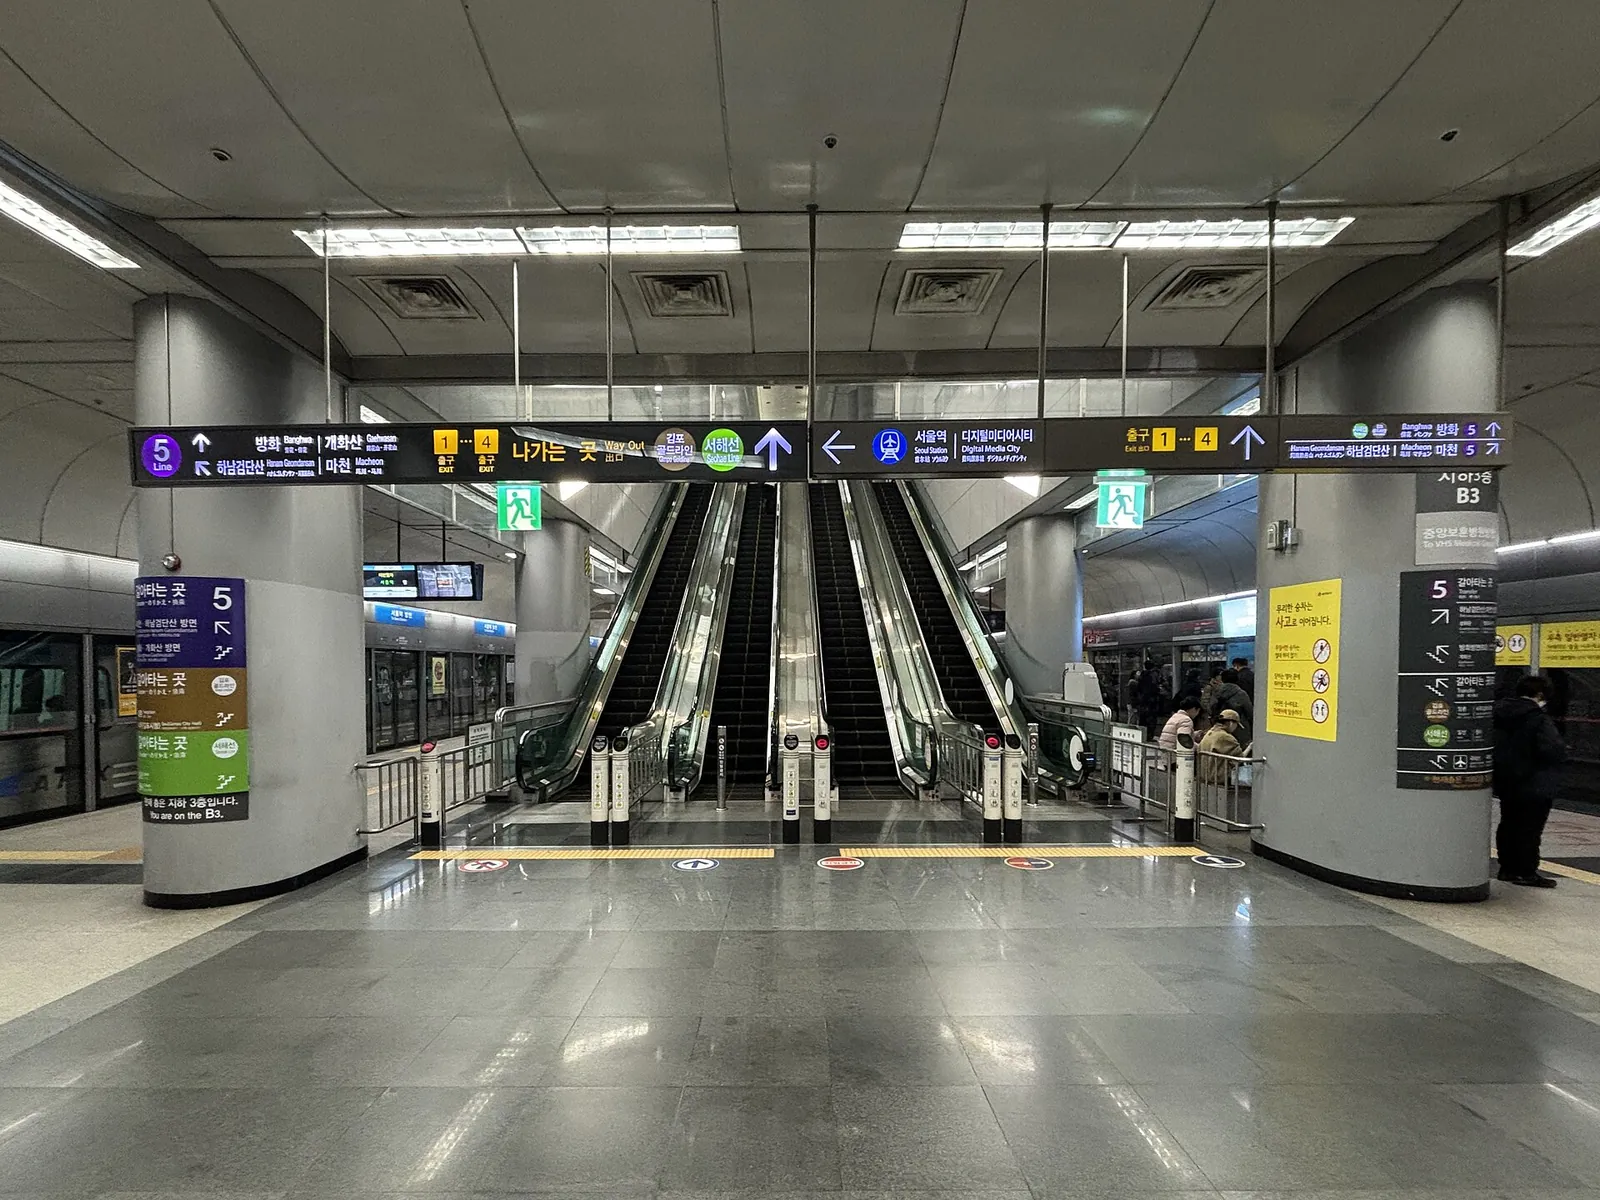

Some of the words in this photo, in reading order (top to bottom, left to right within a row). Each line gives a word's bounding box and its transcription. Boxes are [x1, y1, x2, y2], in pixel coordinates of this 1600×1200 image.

[961, 429, 1033, 443] 디지털미디어시티
[1126, 428, 1150, 442] 출구
[1436, 423, 1459, 436] 방화
[1467, 424, 1476, 435] 5
[283, 435, 314, 444] Banghwa
[325, 434, 364, 450] 개화산
[441, 435, 448, 449] 1
[481, 435, 491, 448] 4
[666, 433, 685, 444] 김포
[914, 430, 947, 443] 서울역
[1160, 432, 1167, 447] 1
[1201, 432, 1211, 446] 4
[153, 438, 170, 462] 5
[255, 436, 281, 452] 방화
[604, 441, 625, 452] Way
[628, 441, 645, 450] Out
[657, 444, 694, 456] 골드라인
[705, 437, 740, 453] 서해선
[914, 446, 929, 454] Seoul
[929, 446, 948, 454] Station
[961, 445, 984, 454] Digital
[1006, 445, 1021, 454] City
[1435, 443, 1458, 456] 마천
[1465, 444, 1475, 456] 5
[512, 441, 567, 462] 나가는
[579, 441, 598, 462] 곳
[1346, 445, 1390, 457] 하남검단산
[355, 457, 384, 466] Macheon
[437, 455, 455, 465] 출구
[478, 455, 496, 465] 출구
[605, 453, 624, 463] 出口
[153, 462, 173, 471] Line
[216, 460, 265, 476] 하남검단산
[325, 458, 352, 474] 마천
[1456, 487, 1480, 504] B3
[171, 583, 187, 598] 곳
[1432, 580, 1447, 599] 5
[212, 586, 232, 610] 5
[180, 618, 198, 628] 방면
[165, 643, 181, 652] 방면
[172, 672, 187, 687] 곳
[173, 736, 188, 750] 곳
[168, 797, 187, 809] 지하
[189, 796, 239, 808] 3층입니다.
[174, 812, 185, 820] on
[187, 811, 202, 819] the
[205, 808, 224, 819] B3.
